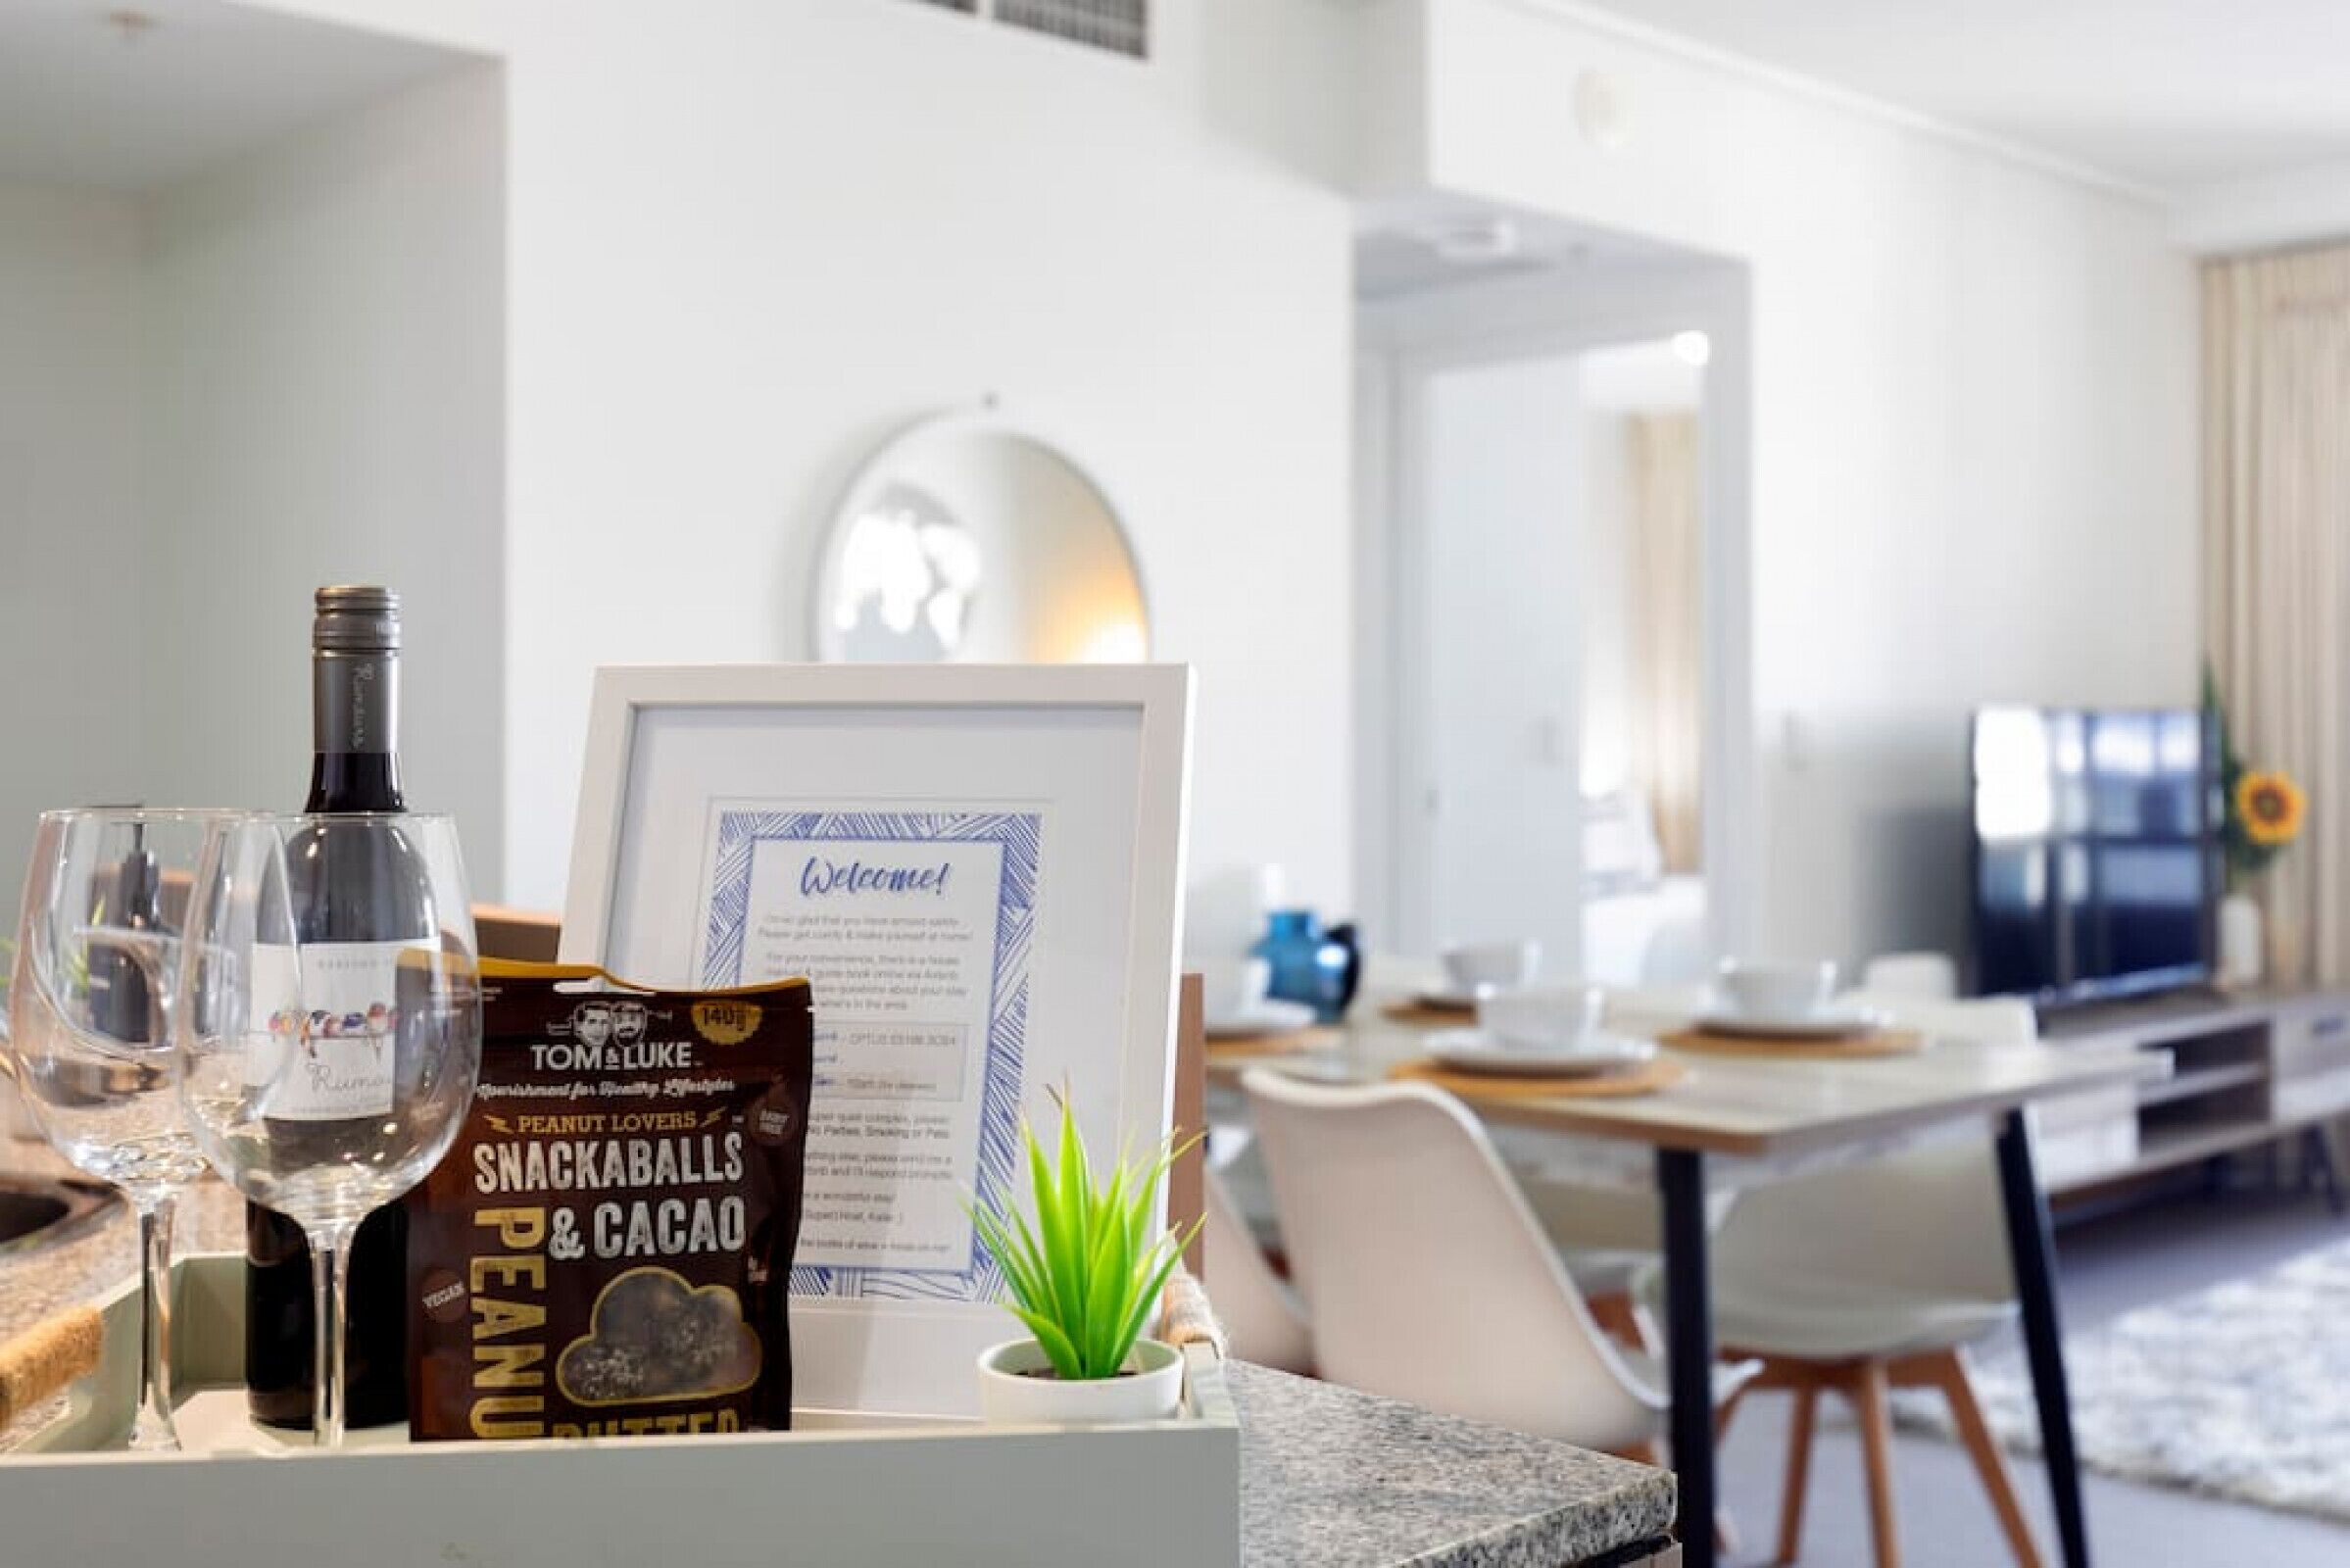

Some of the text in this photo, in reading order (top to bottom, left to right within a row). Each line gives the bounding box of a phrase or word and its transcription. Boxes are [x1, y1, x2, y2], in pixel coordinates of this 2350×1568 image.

[800, 856, 950, 896] Welcome!
[704, 1006, 749, 1032] 140g
[530, 1043, 603, 1071] TOM
[623, 1042, 693, 1069] LUKE
[516, 1111, 697, 1133] PEANUT LOVERS
[473, 1131, 745, 1194] SNACKABALLS
[549, 1196, 745, 1259] & CACAO
